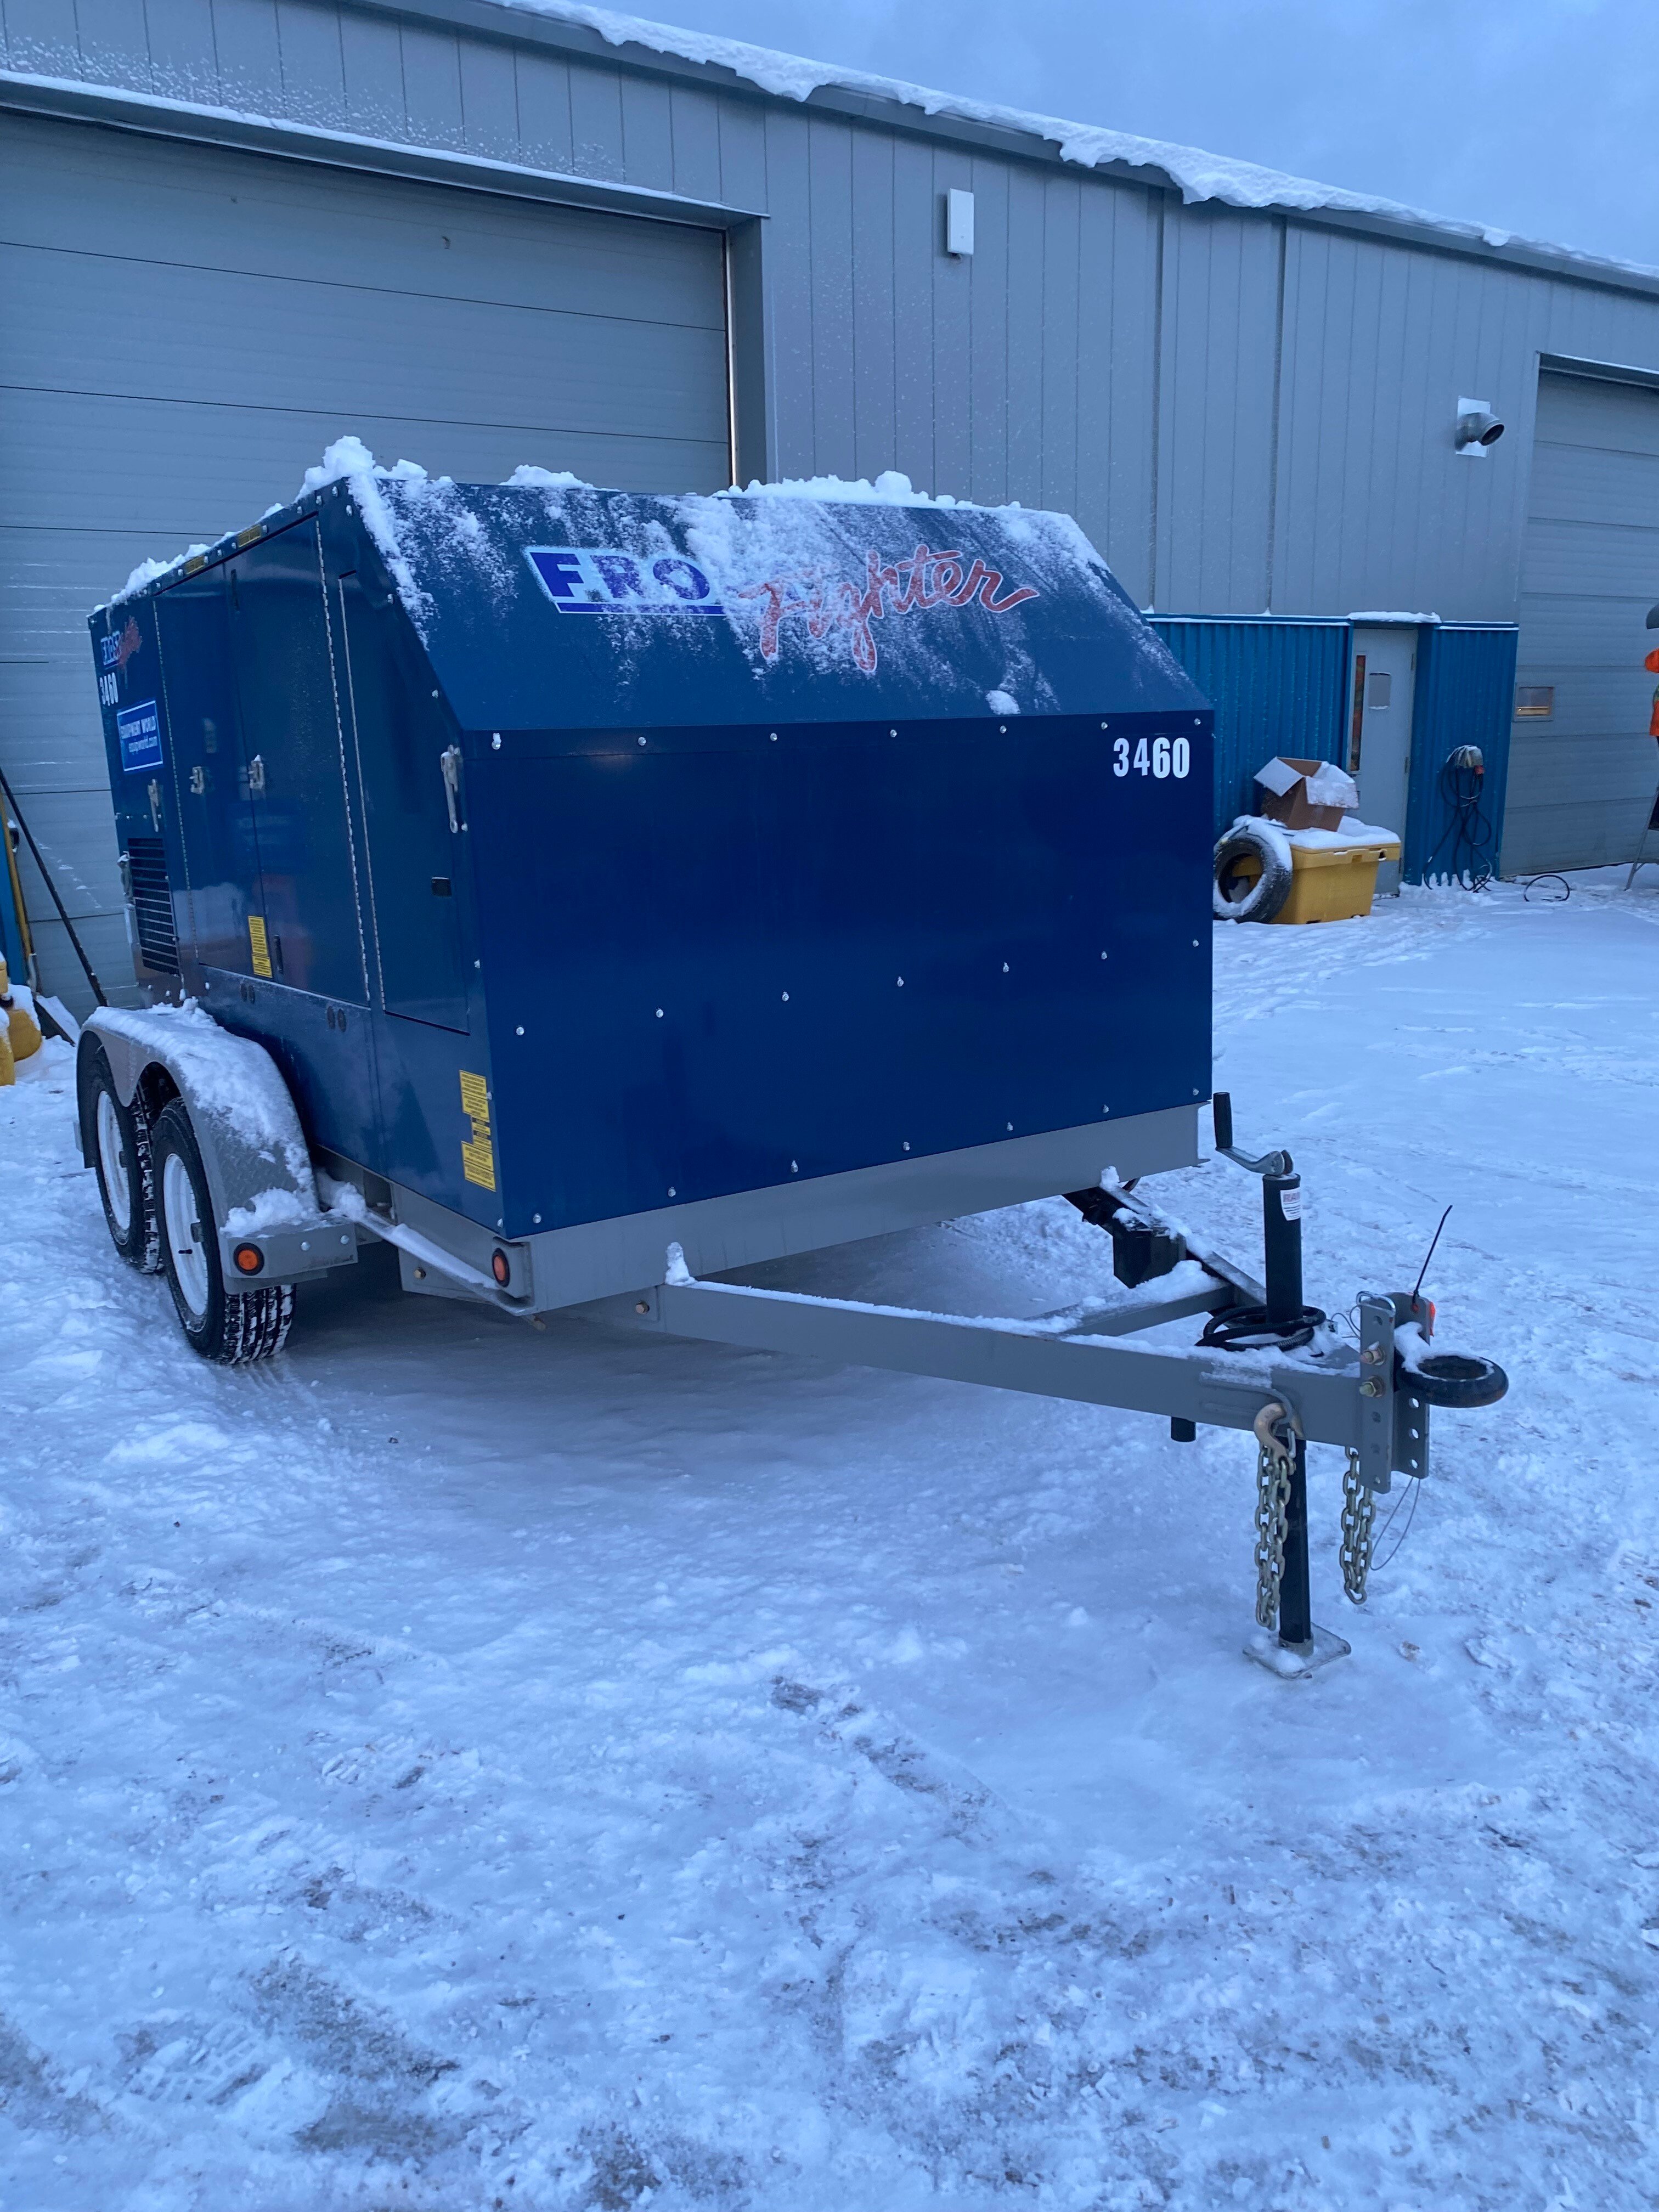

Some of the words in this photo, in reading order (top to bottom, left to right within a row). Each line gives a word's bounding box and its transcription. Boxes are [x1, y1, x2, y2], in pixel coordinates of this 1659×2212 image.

[529, 551, 711, 600] FRO
[737, 544, 1040, 674] Fighter
[99, 672, 119, 706] 3460
[1113, 737, 1190, 778] 3460
